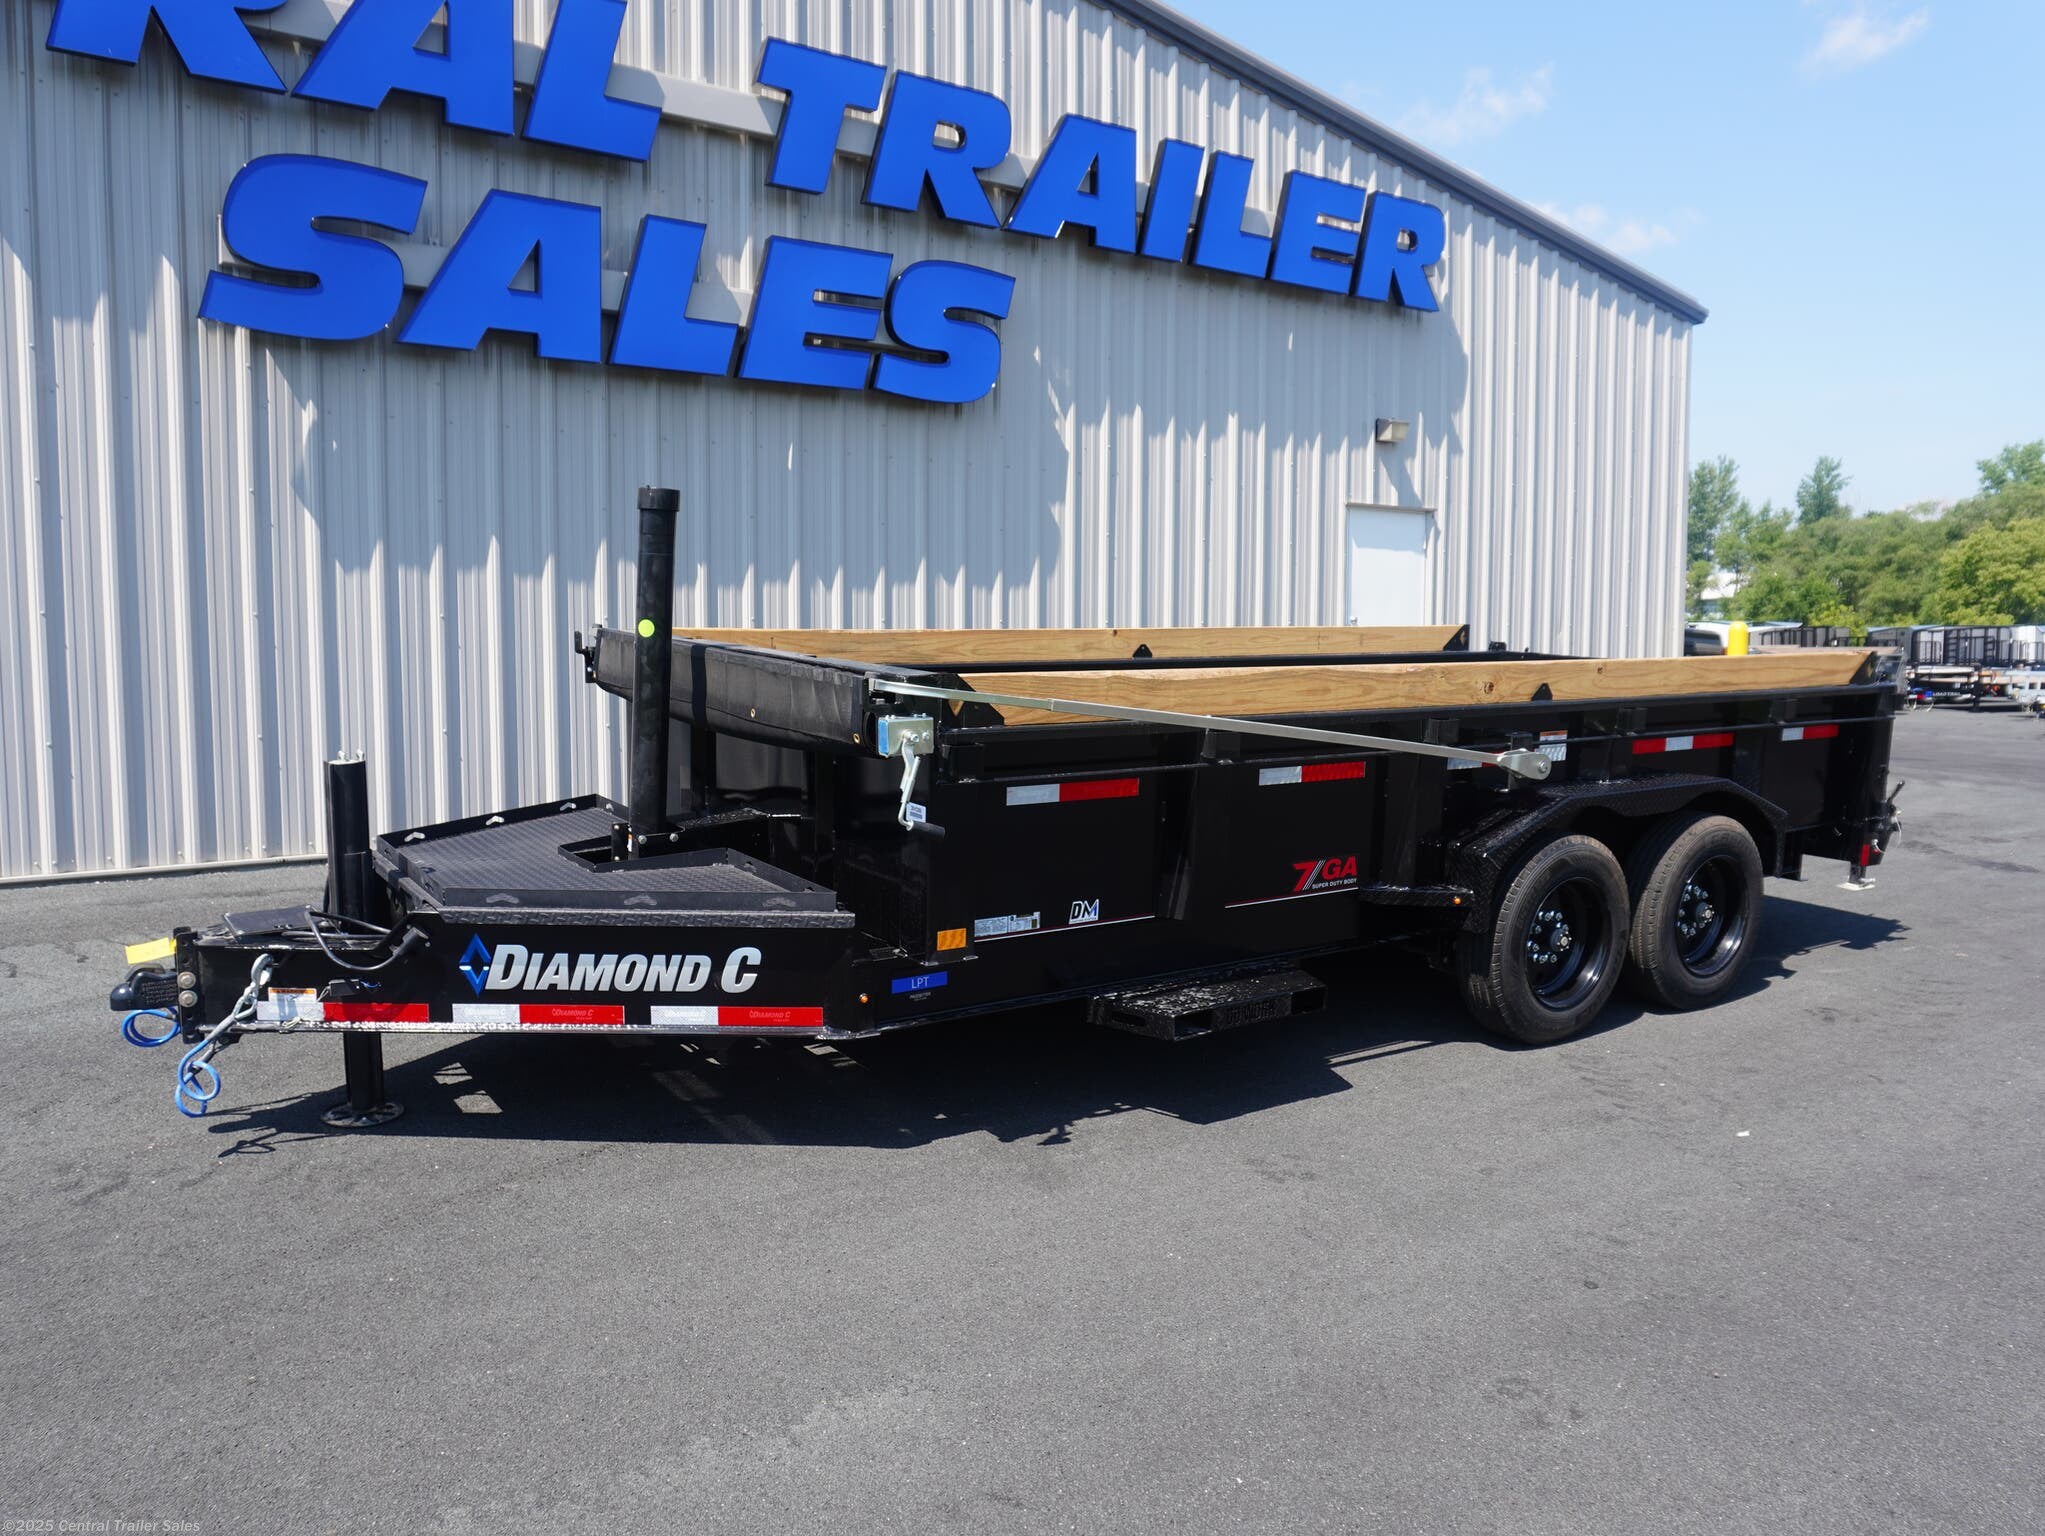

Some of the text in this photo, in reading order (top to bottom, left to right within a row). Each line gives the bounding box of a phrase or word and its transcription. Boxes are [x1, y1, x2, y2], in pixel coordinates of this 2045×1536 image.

[754, 36, 1446, 312] TRAILER
[197, 152, 1016, 405] SALES
[484, 944, 762, 994] DIAMOND C
[911, 976, 929, 989] LPT
[555, 1009, 587, 1017] DIAMOND
